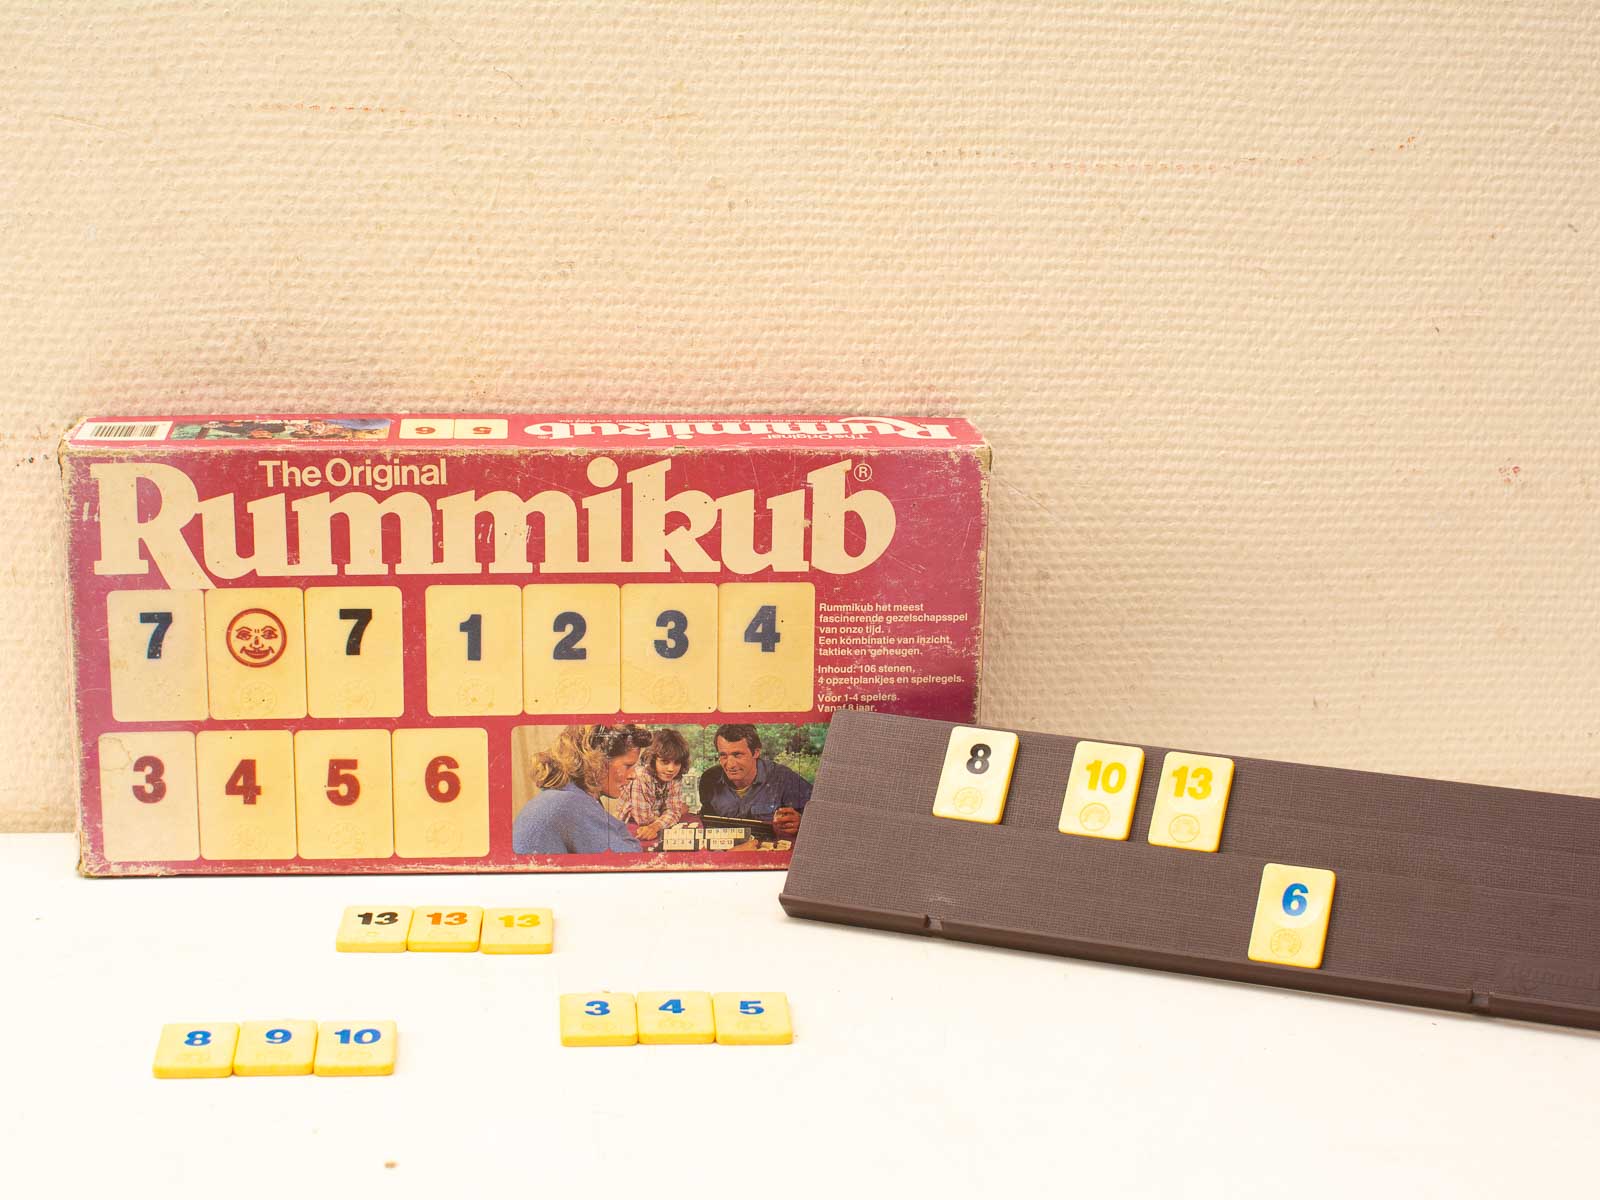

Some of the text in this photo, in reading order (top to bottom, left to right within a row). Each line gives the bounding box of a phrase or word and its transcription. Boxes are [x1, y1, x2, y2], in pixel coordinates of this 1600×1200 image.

[524, 416, 957, 440] Rummikub
[258, 458, 447, 491] The Original
[90, 456, 897, 590] Rummikub
[819, 603, 924, 612] Rummikub het meest
[819, 612, 968, 624] fascinerende gezelschapsspel
[139, 608, 373, 660] 7 7
[459, 605, 781, 662] 1 2 3 4
[820, 624, 884, 635] van onze tijd.
[818, 635, 952, 645] Een kombinatie van inzicht,
[819, 648, 852, 656] taktiek
[870, 647, 923, 657] geheugen.
[860, 664, 876, 673] 106
[878, 665, 916, 674] stenen,
[826, 676, 894, 686] opzetplankjes
[911, 674, 964, 685] spelregels.
[818, 692, 900, 702] Voor 1-4 spelers.
[965, 743, 992, 775] 8
[132, 755, 461, 806] 3 4 5 6
[1085, 759, 1127, 794] 10
[1171, 765, 1213, 800] 13
[1282, 882, 1309, 917] 6
[357, 911, 541, 928] 13 13 13
[585, 999, 765, 1016] 3 4 5
[184, 1028, 382, 1047] 8 9 10
